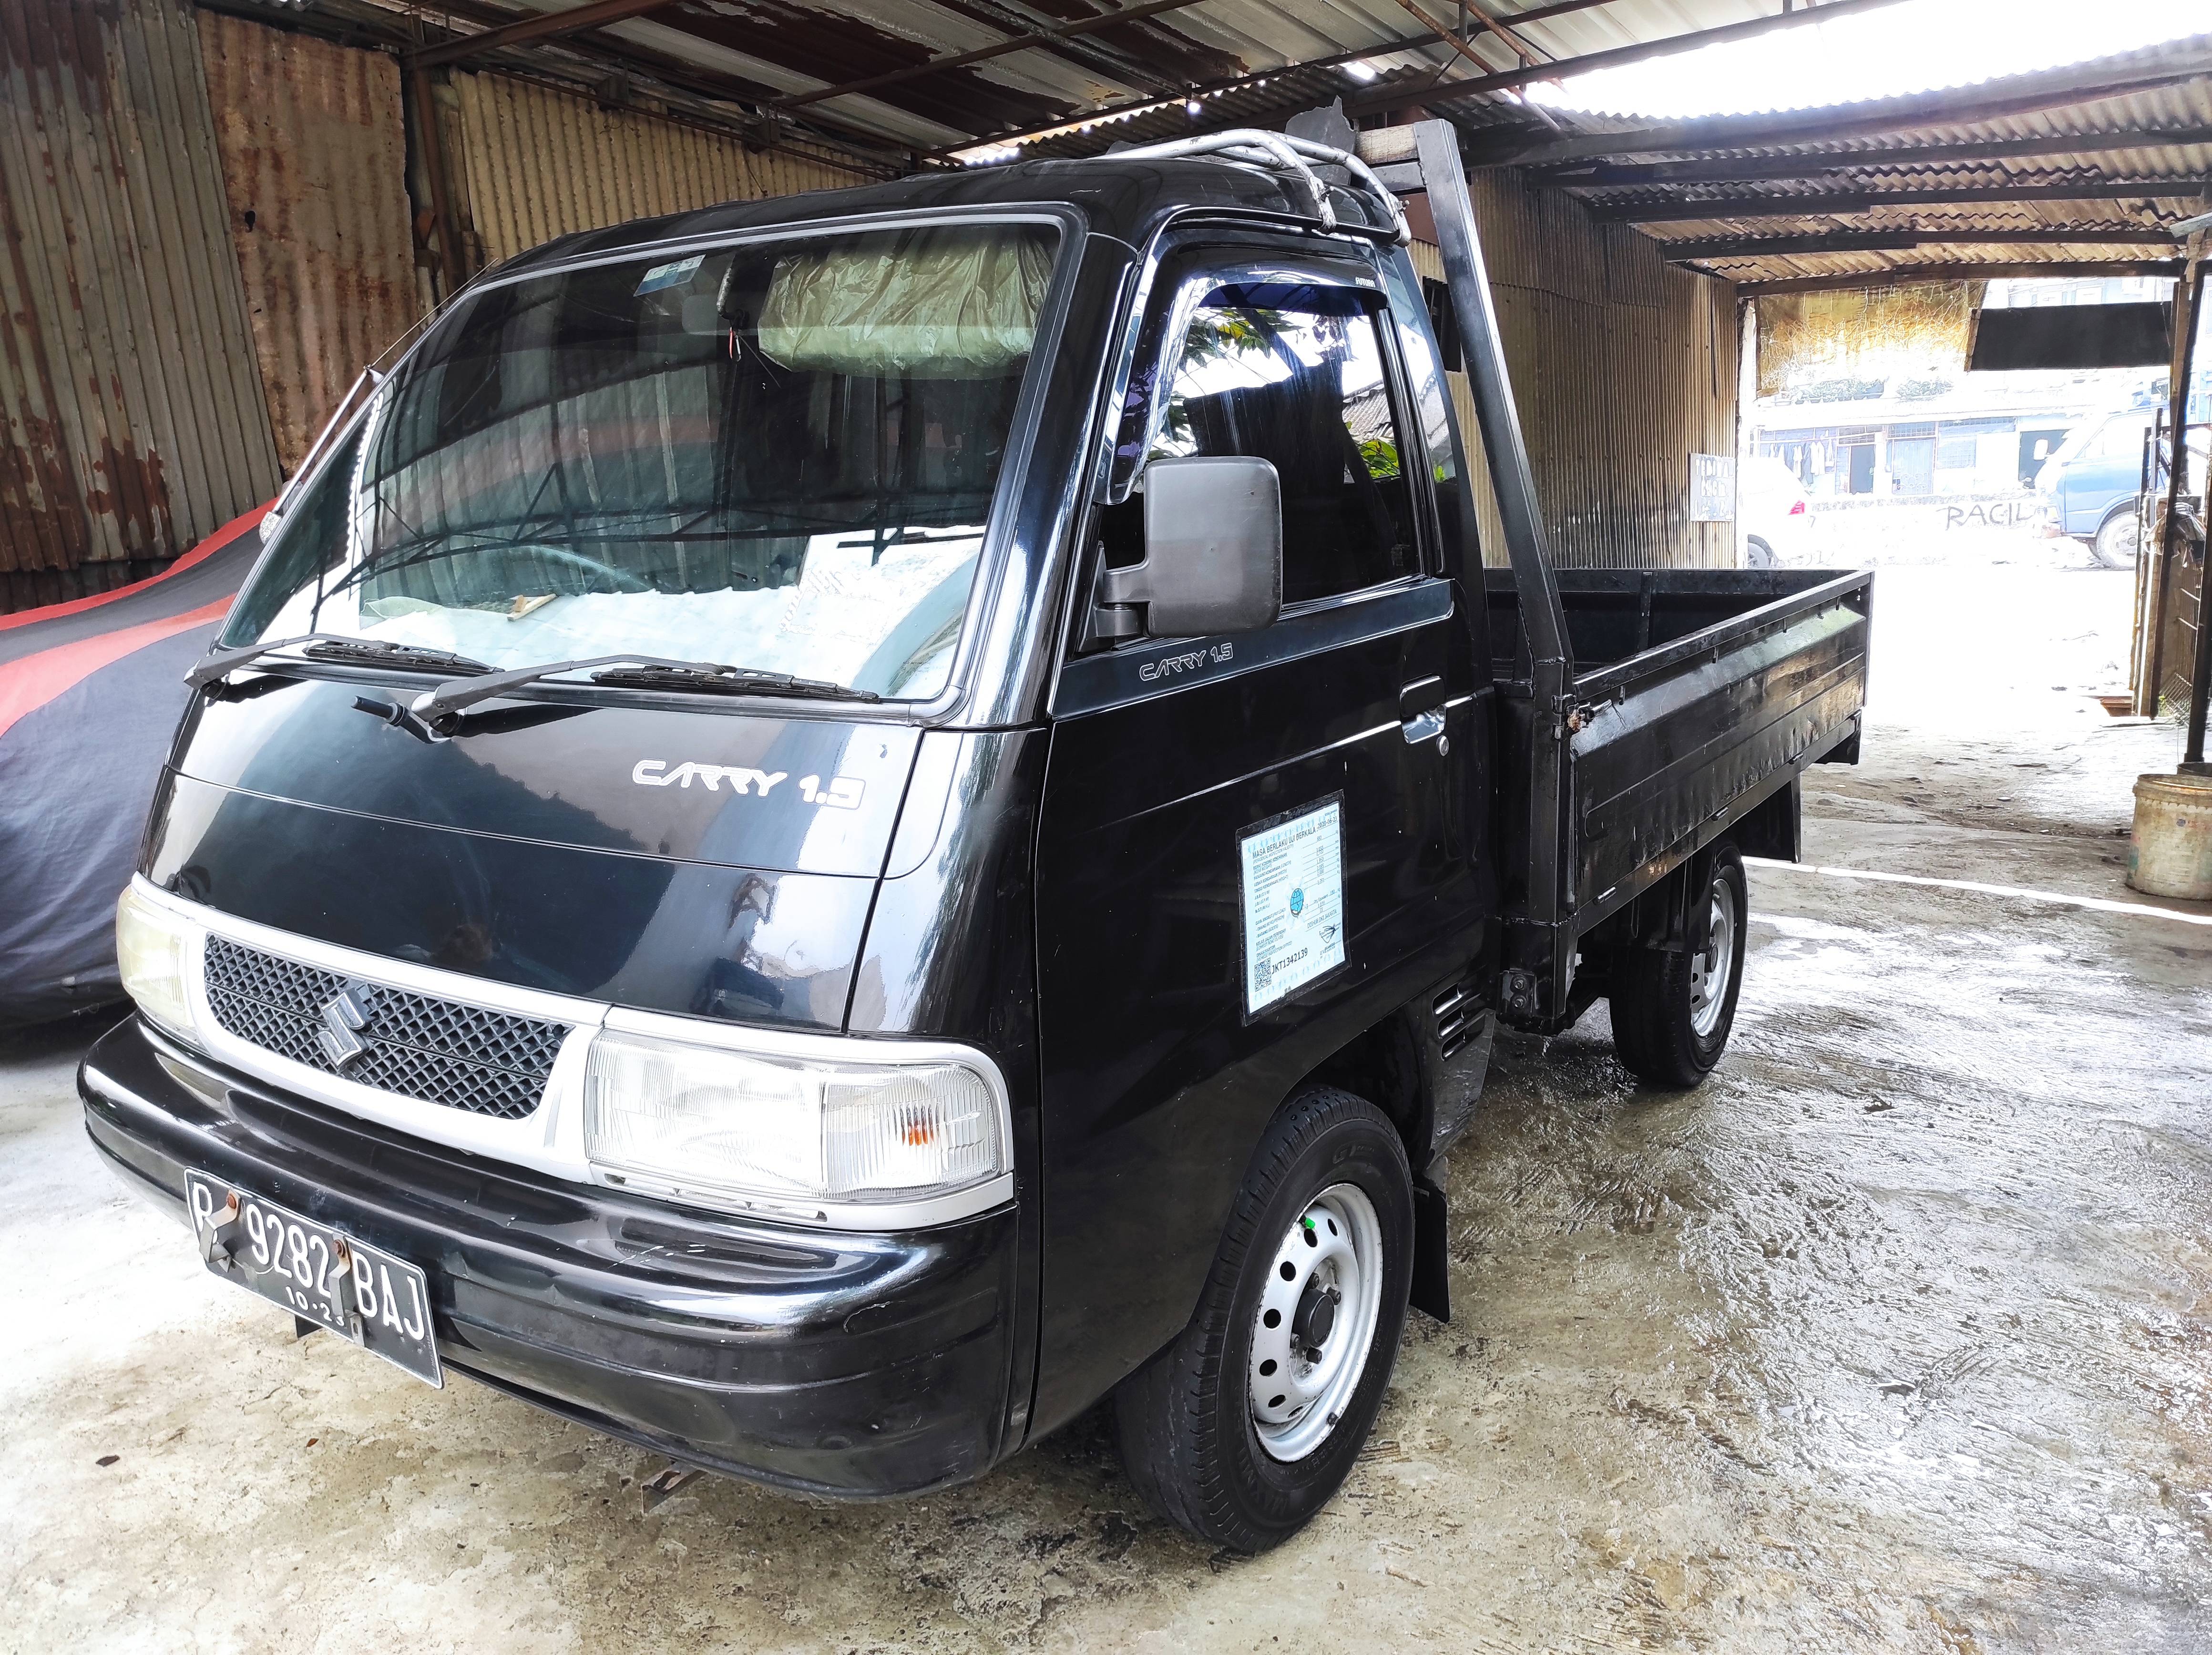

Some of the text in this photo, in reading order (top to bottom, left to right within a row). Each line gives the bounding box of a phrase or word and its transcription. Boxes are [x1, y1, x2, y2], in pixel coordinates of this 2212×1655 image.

[1355, 276, 1376, 288] FUTURA
[1139, 642, 1233, 682] CARRY 1.5
[632, 758, 789, 797] CARRY
[1252, 847, 1266, 859] MASA
[1266, 837, 1287, 853] BERLAKU
[1271, 947, 1308, 974] JKT1342139
[246, 1204, 332, 1298] 9282
[352, 1250, 425, 1340] BAJ
